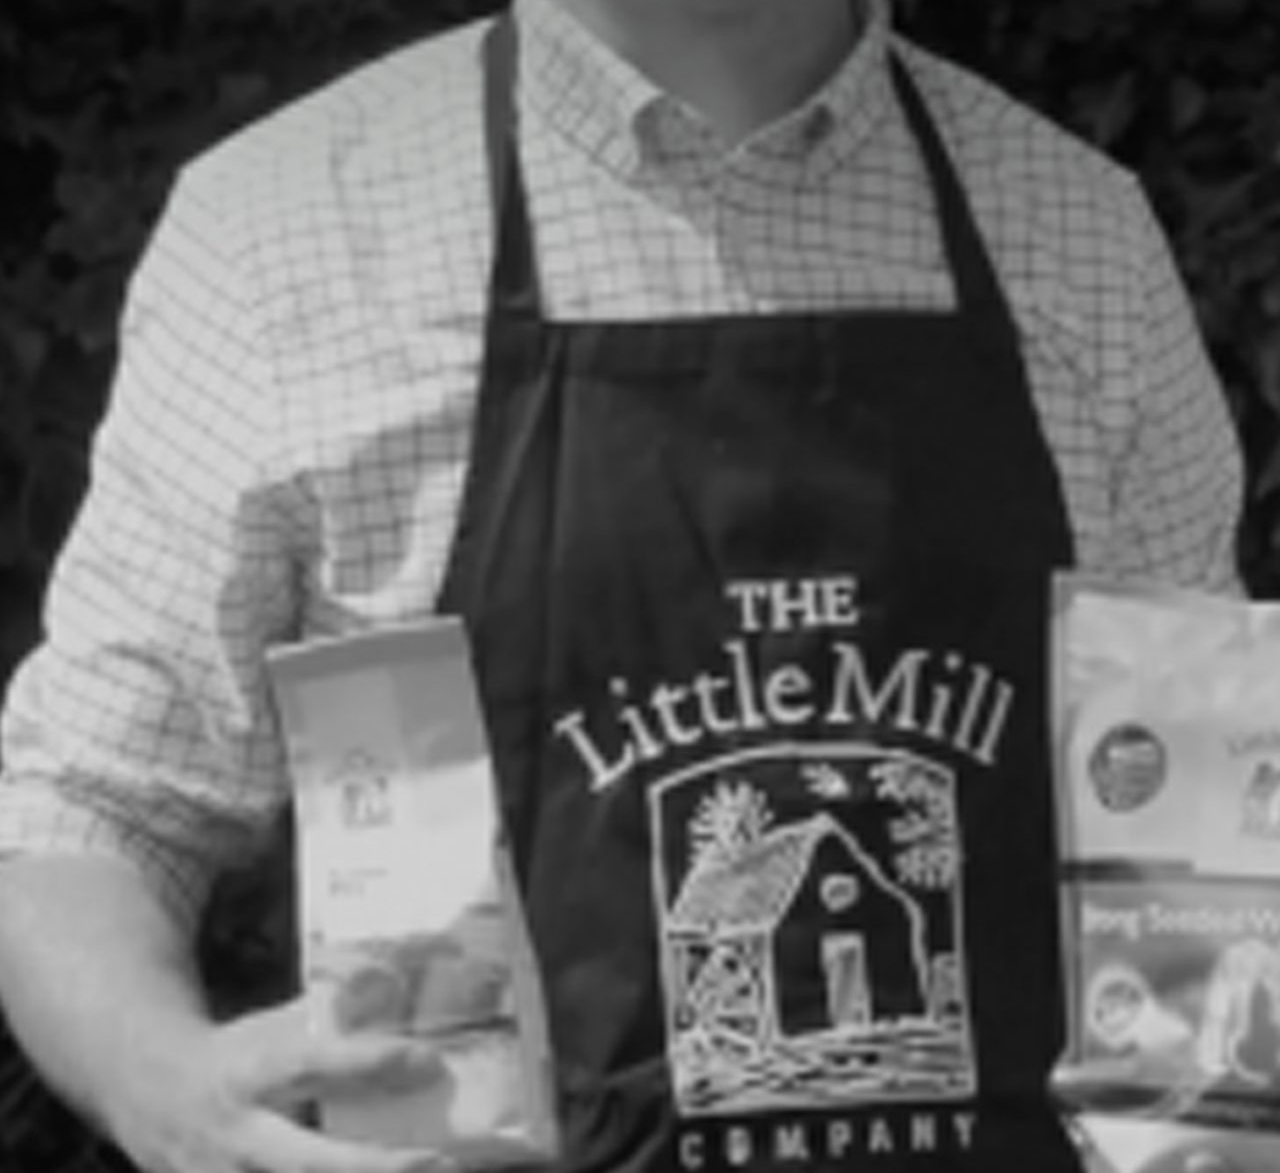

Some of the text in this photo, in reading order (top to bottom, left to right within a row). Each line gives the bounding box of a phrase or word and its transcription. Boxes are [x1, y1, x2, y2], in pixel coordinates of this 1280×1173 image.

[724, 576, 860, 630] THE
[553, 639, 1014, 792] Little Mill
[678, 1112, 977, 1171] COMPANY
